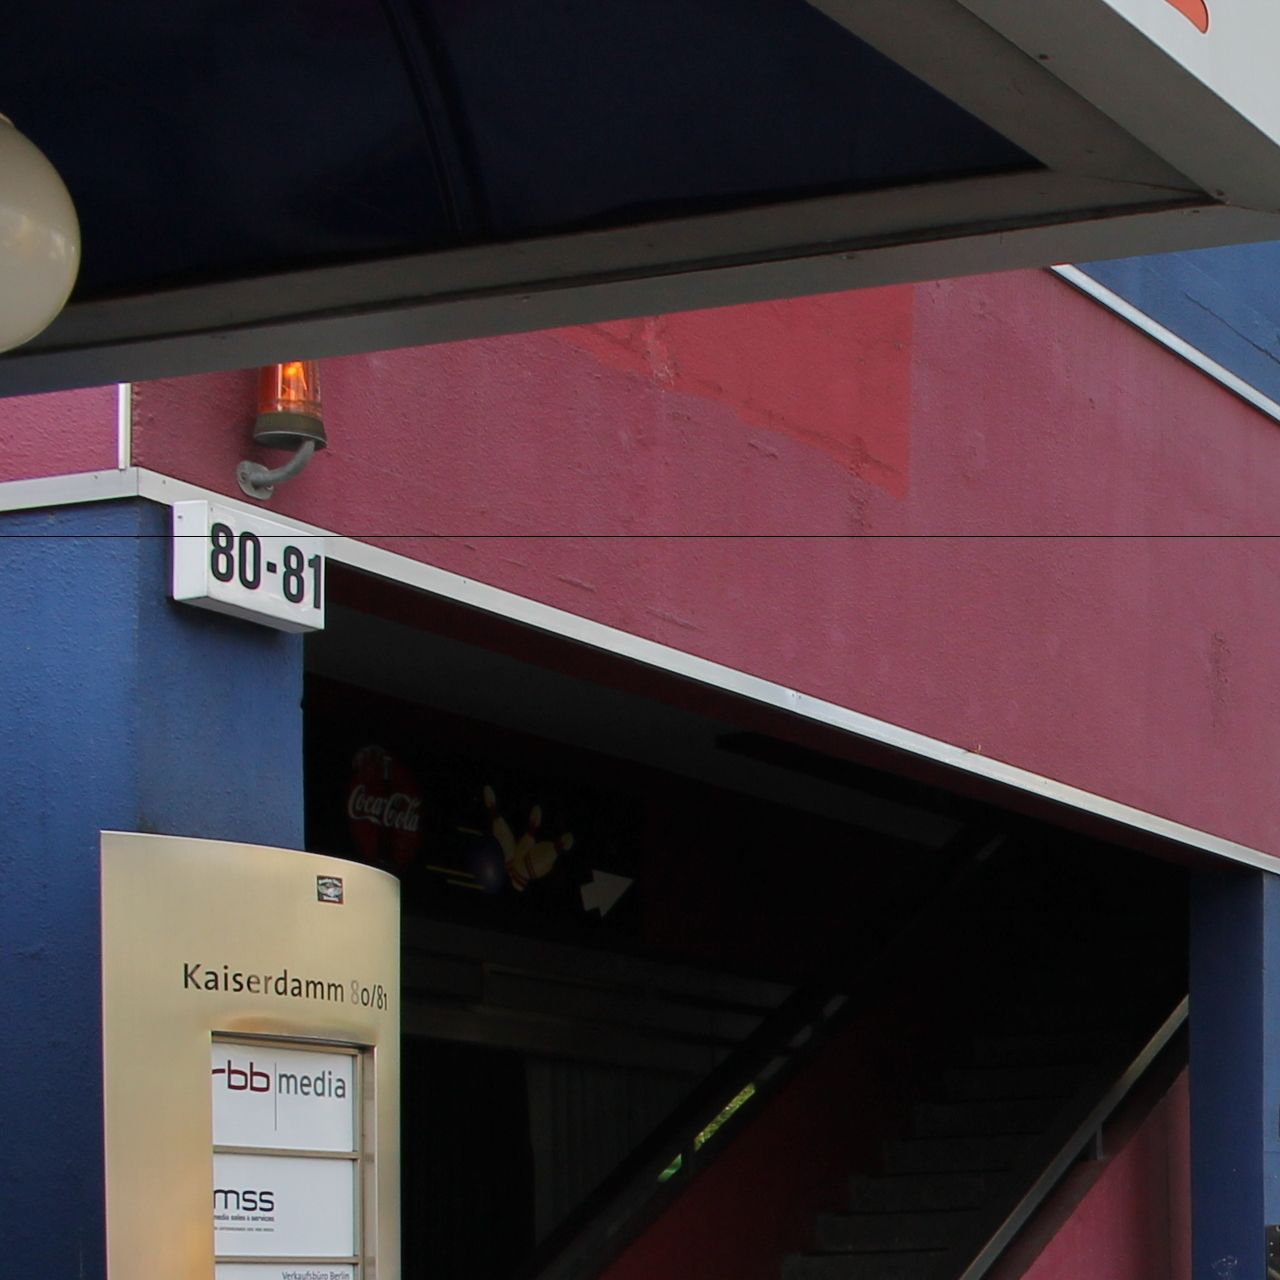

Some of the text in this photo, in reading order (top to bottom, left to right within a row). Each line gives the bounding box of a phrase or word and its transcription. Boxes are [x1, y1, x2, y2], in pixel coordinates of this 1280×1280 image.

[210, 522, 323, 609] 80-81
[183, 963, 388, 1011] Kaiserdamm 80/81
[278, 1071, 346, 1099] media
[213, 1189, 275, 1212] mss
[282, 1271, 351, 1280] Verkaufsbüro Berlin
